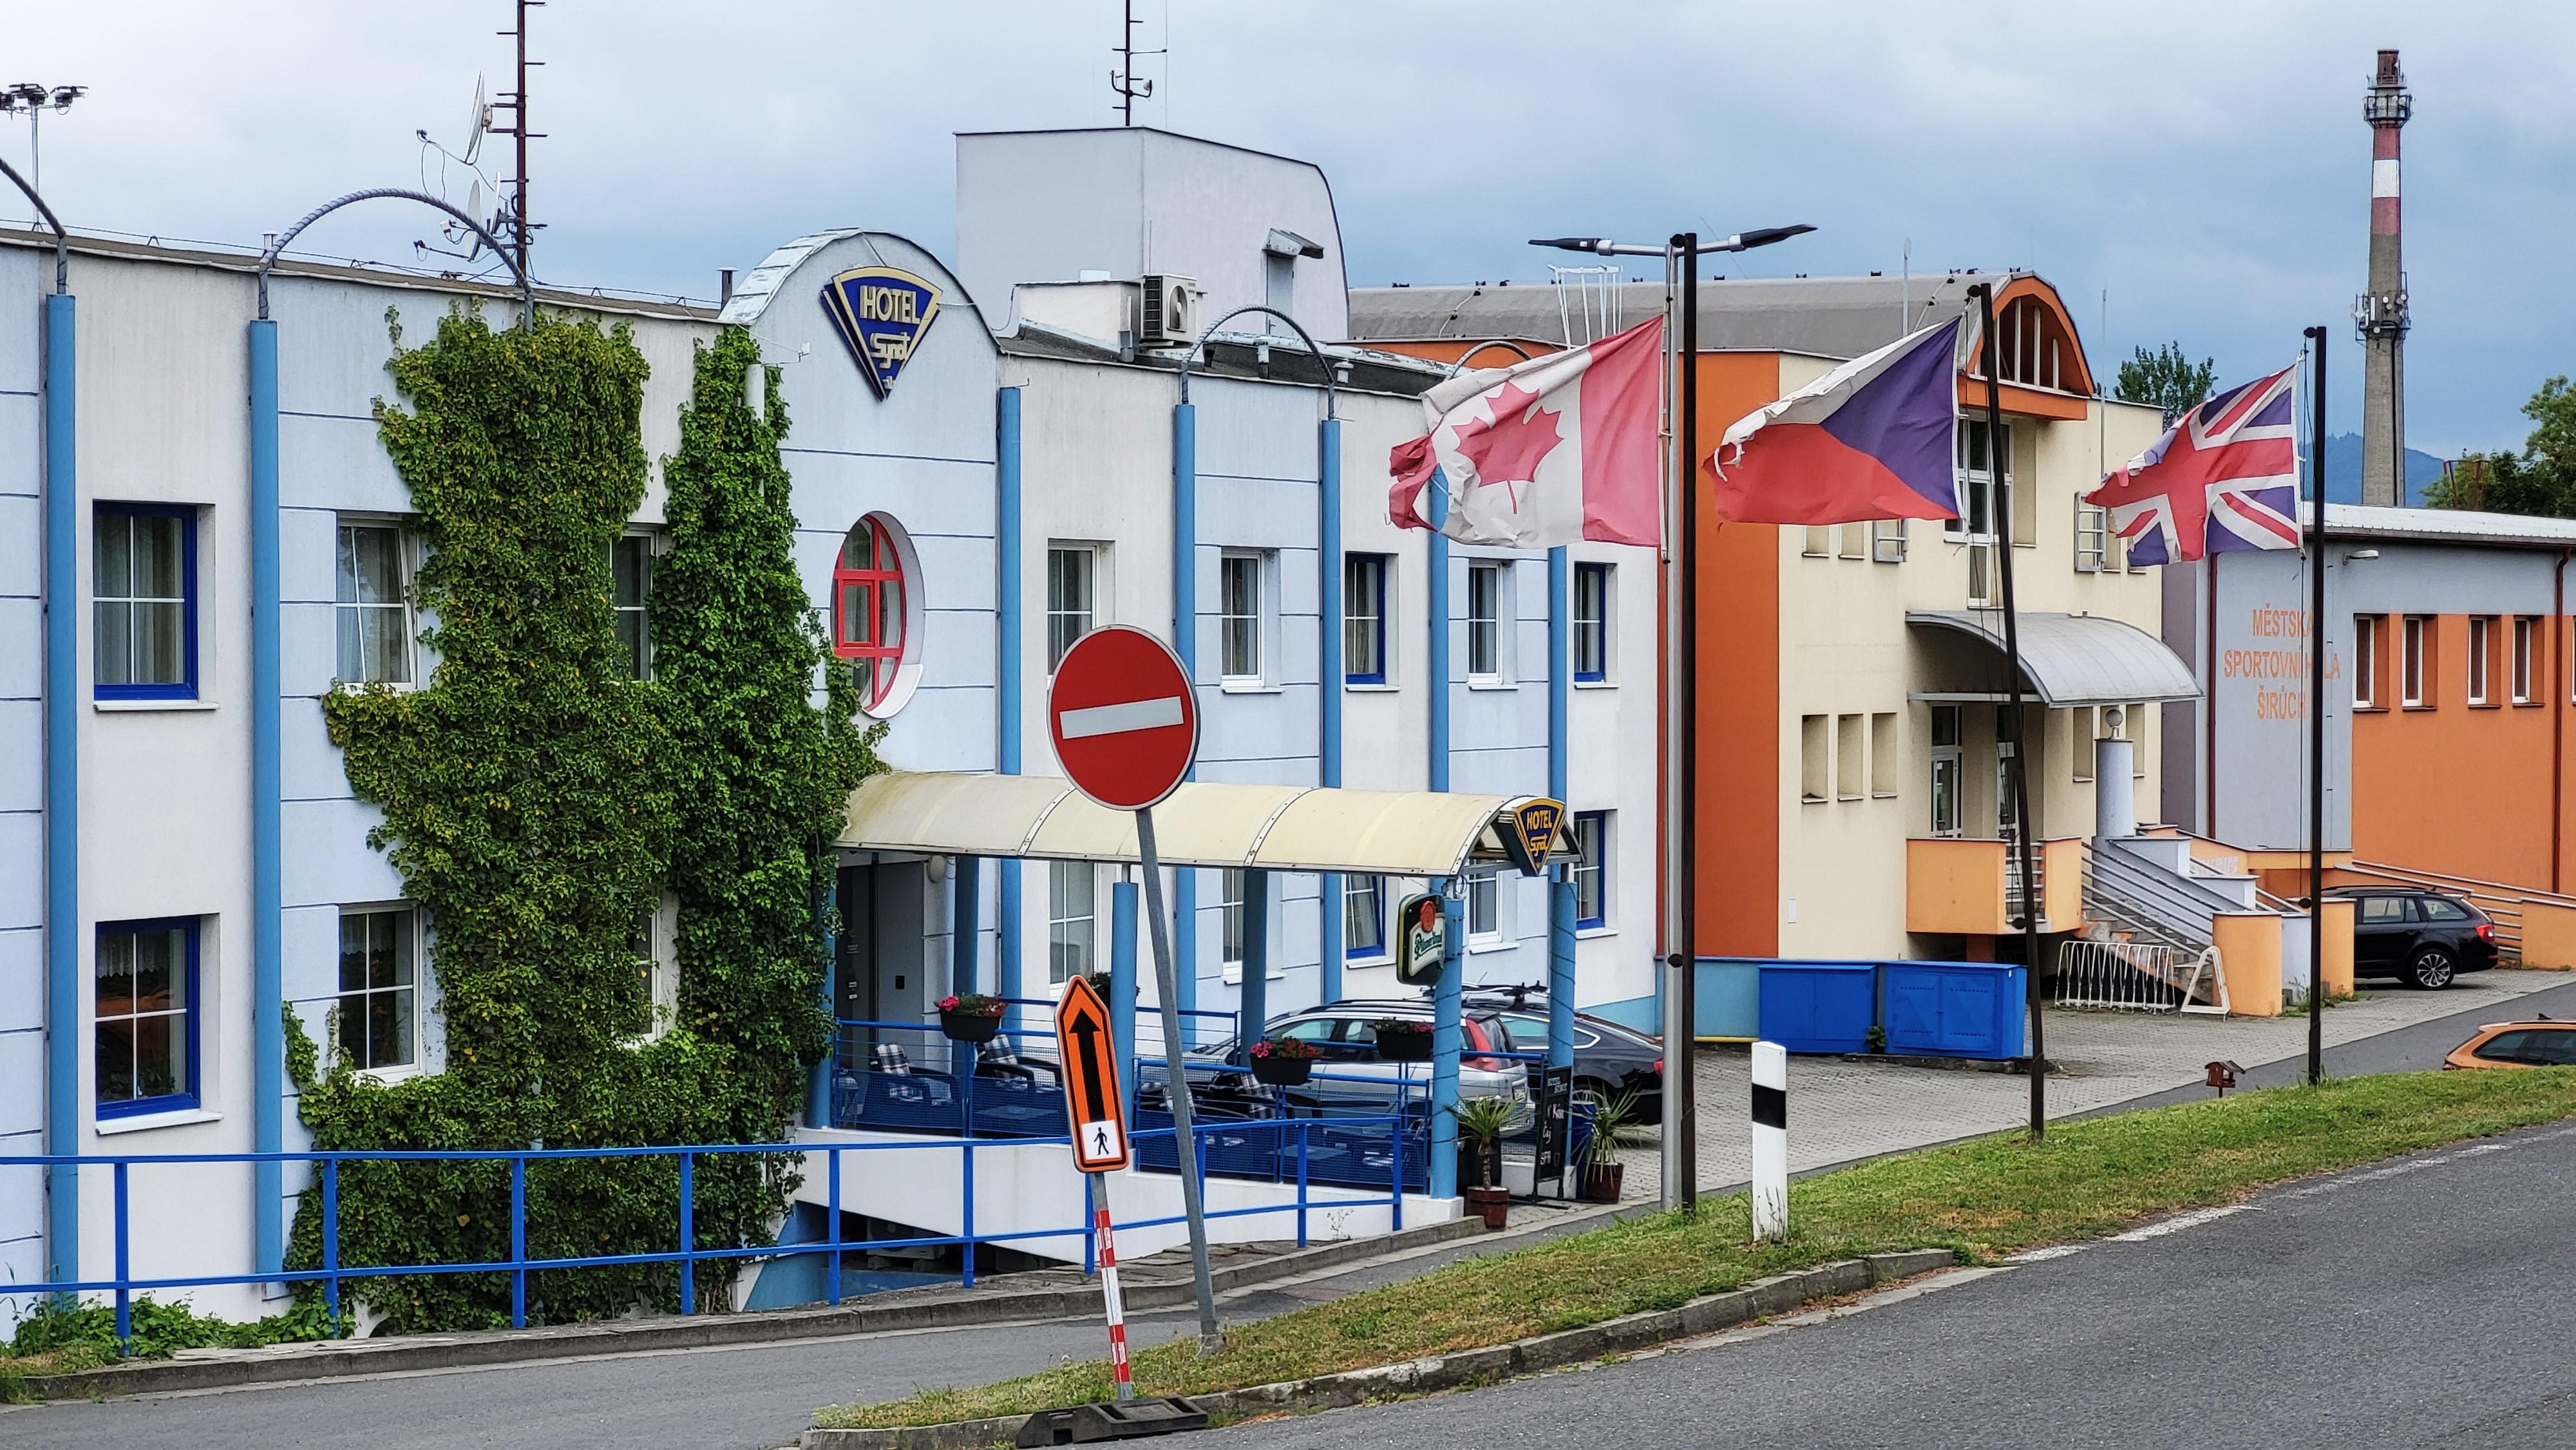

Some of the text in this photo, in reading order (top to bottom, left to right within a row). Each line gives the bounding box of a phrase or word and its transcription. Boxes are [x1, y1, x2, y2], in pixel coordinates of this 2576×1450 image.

[859, 285, 920, 325] HOTEL
[2224, 646, 2340, 679] SPORTOVNÍ HLA
[1527, 810, 1552, 831] HOTEL
